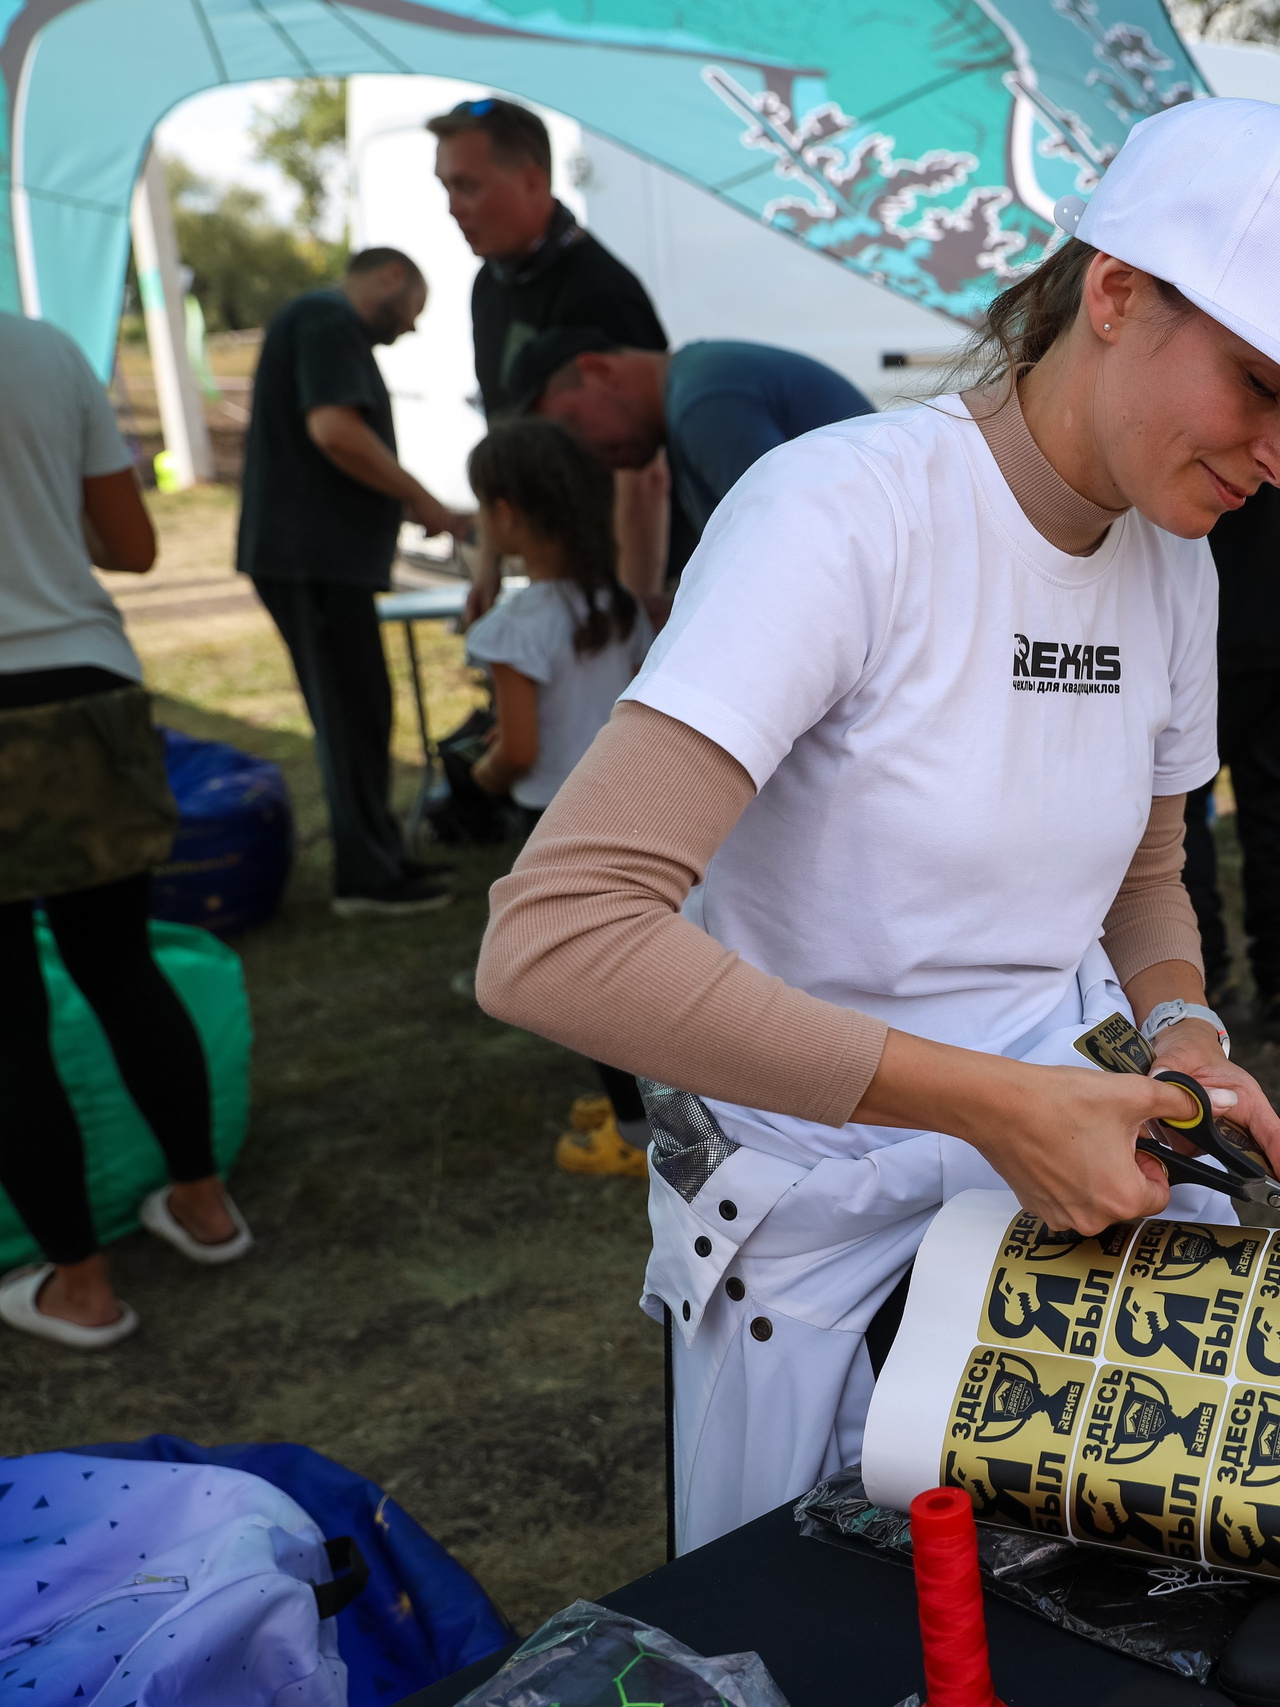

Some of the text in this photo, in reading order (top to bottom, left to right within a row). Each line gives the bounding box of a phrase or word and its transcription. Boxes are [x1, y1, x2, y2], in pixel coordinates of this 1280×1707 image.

[1013, 633, 1121, 681] REXAS
[1013, 680, 1035, 691] чехлы
[1037, 682, 1059, 694] для
[1004, 1211, 1040, 1259] ЗДЕС
[1130, 1221, 1171, 1278] ЗДЕСЬ
[1235, 1241, 1256, 1273] REXAS
[1069, 1268, 1115, 1357] БЫЛ
[1200, 1288, 1244, 1376] БЫЛ
[952, 1350, 996, 1440] ЗДЕСЬ
[1058, 1384, 1080, 1430] REXAS
[1082, 1369, 1124, 1462] ЗДЕСЬ
[1191, 1406, 1212, 1452] REXAS
[1217, 1389, 1256, 1484] ЗДЕСЬ
[1168, 1473, 1200, 1561] БЫЛ
